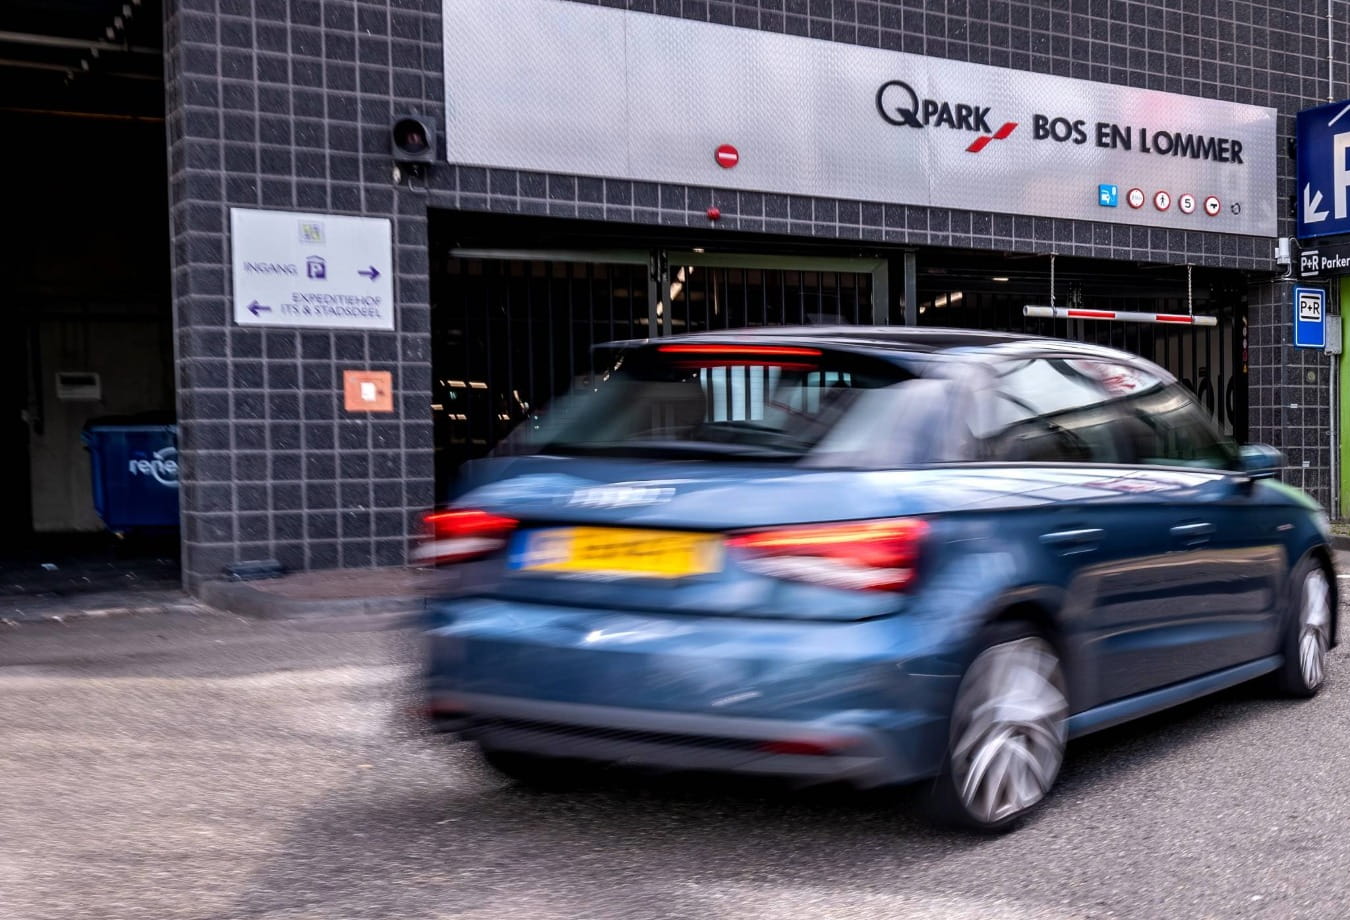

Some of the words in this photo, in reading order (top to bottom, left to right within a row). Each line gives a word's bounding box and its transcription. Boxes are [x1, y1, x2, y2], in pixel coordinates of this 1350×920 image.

[1033, 114, 1088, 145] BOS
[1095, 122, 1132, 151] EN
[1139, 128, 1244, 164] LOMMER
[1184, 198, 1192, 209] 5
[244, 262, 298, 276] INGANG
[1300, 255, 1319, 272] P+R
[1300, 301, 1320, 315] P+R
